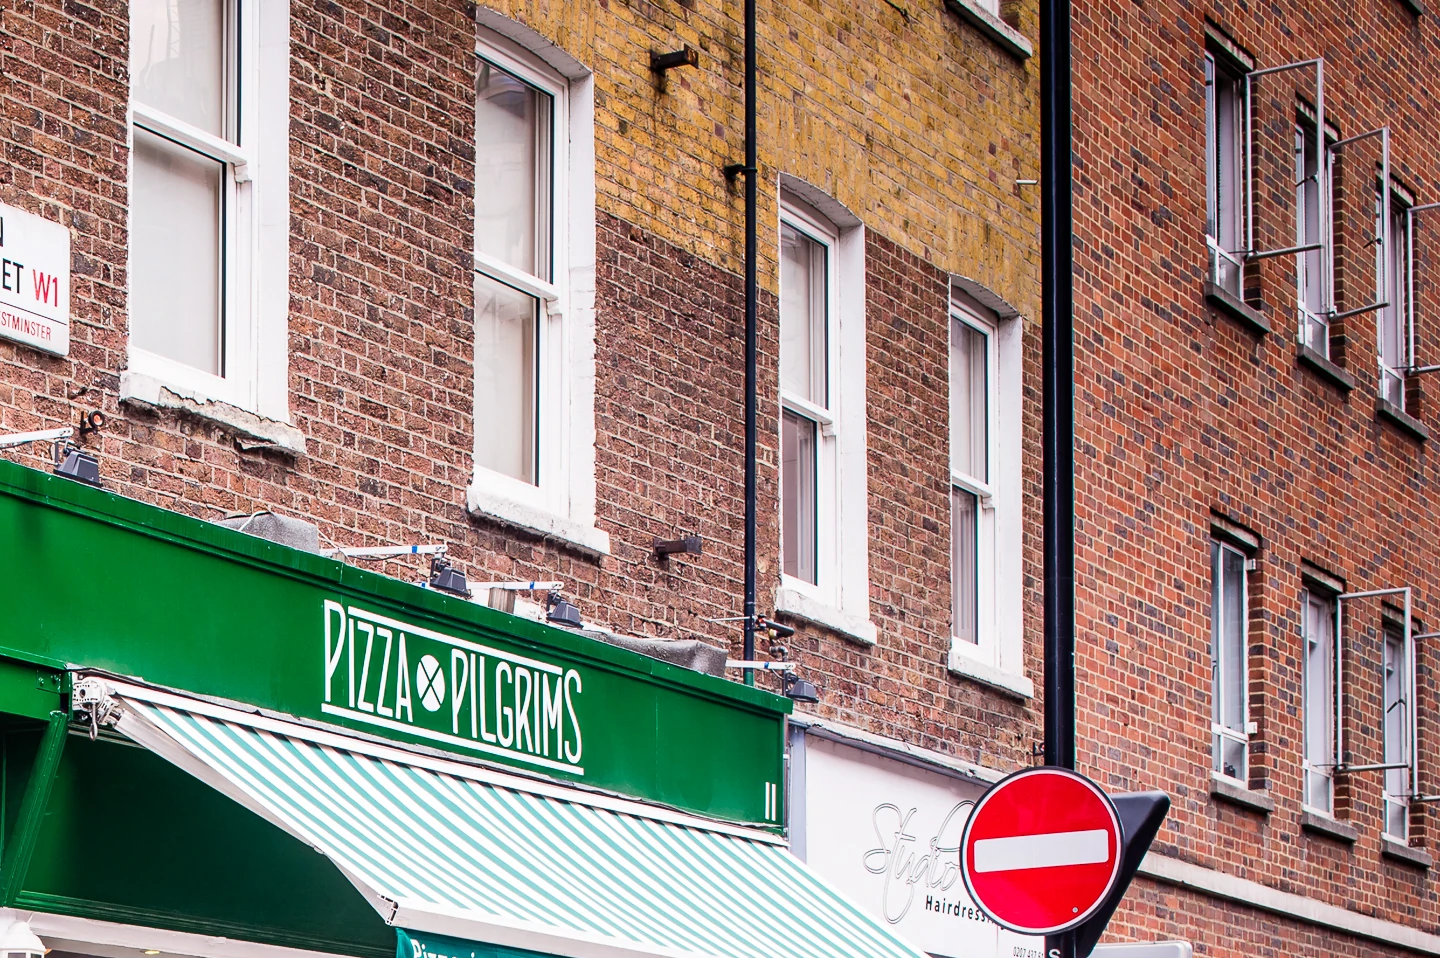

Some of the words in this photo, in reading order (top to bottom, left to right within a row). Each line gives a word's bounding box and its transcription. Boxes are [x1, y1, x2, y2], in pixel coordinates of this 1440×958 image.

[32, 268, 58, 308] W1
[324, 599, 414, 722] PIZZA
[451, 648, 583, 764] PILGRIMS
